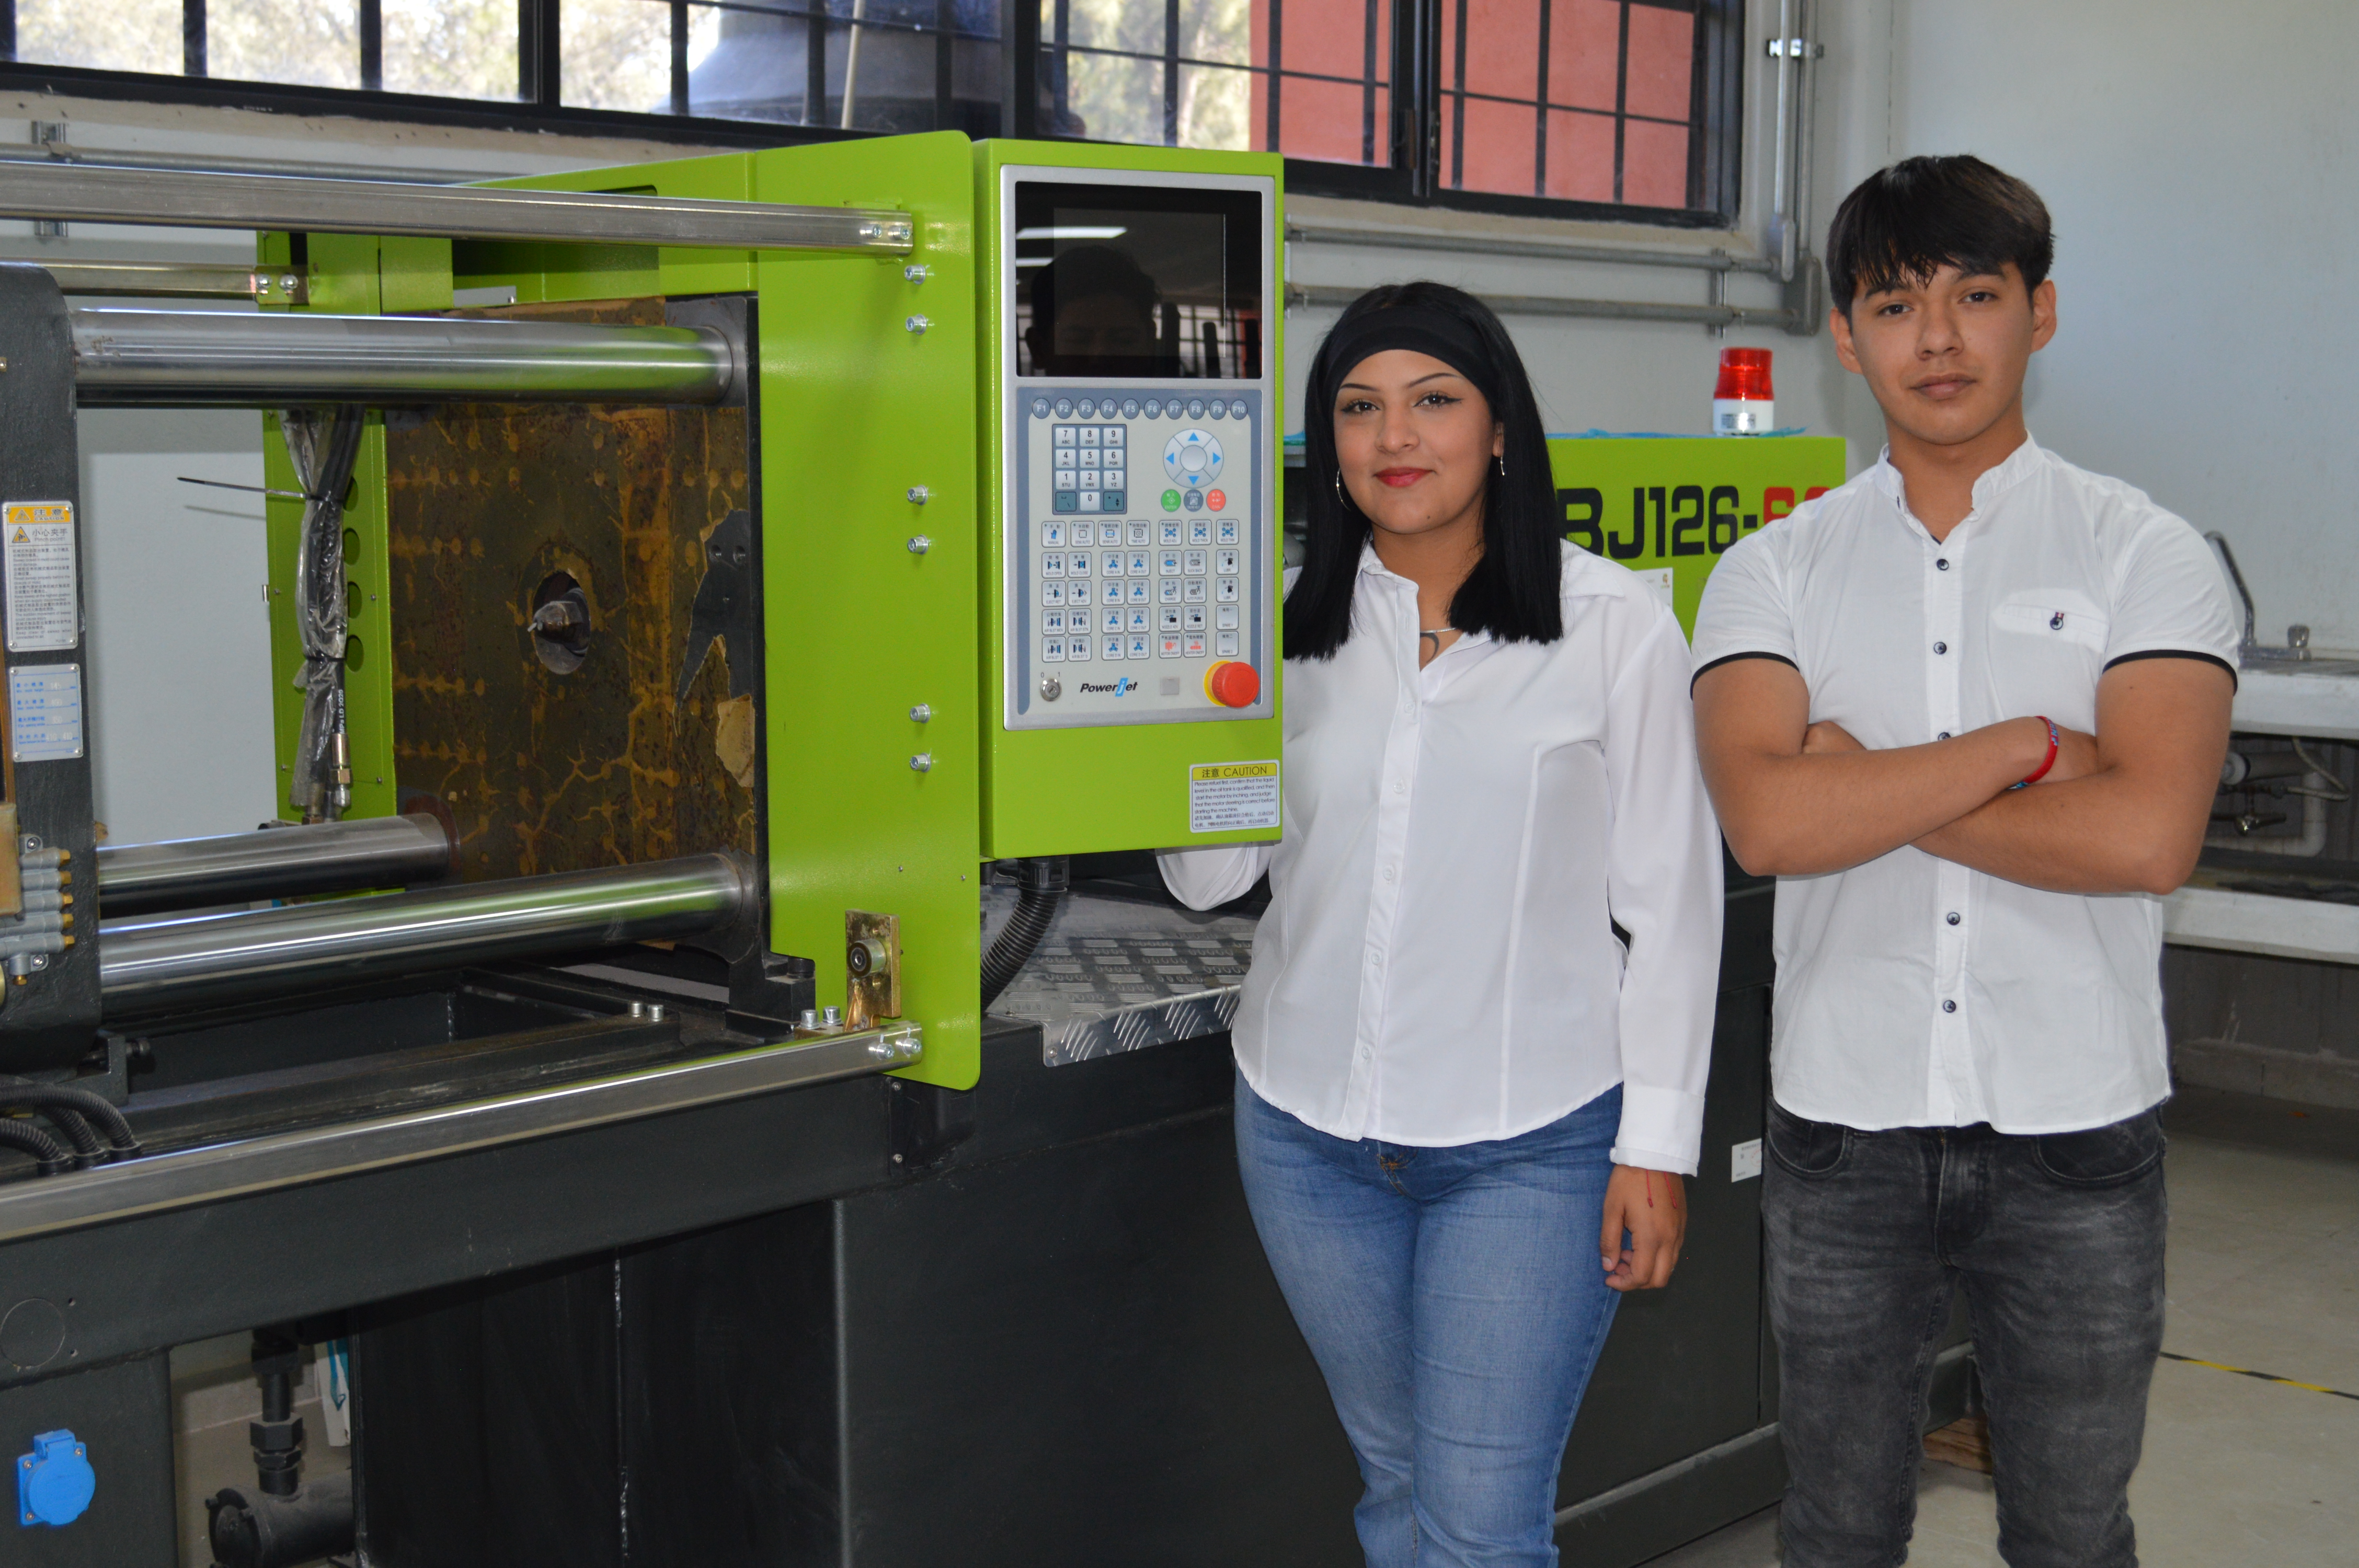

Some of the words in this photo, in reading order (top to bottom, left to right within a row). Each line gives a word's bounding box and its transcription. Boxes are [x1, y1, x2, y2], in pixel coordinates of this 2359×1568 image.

[32, 528, 68, 537] 小心夹手
[1202, 768, 1219, 778] 注意
[1223, 766, 1267, 777] CAUTION
